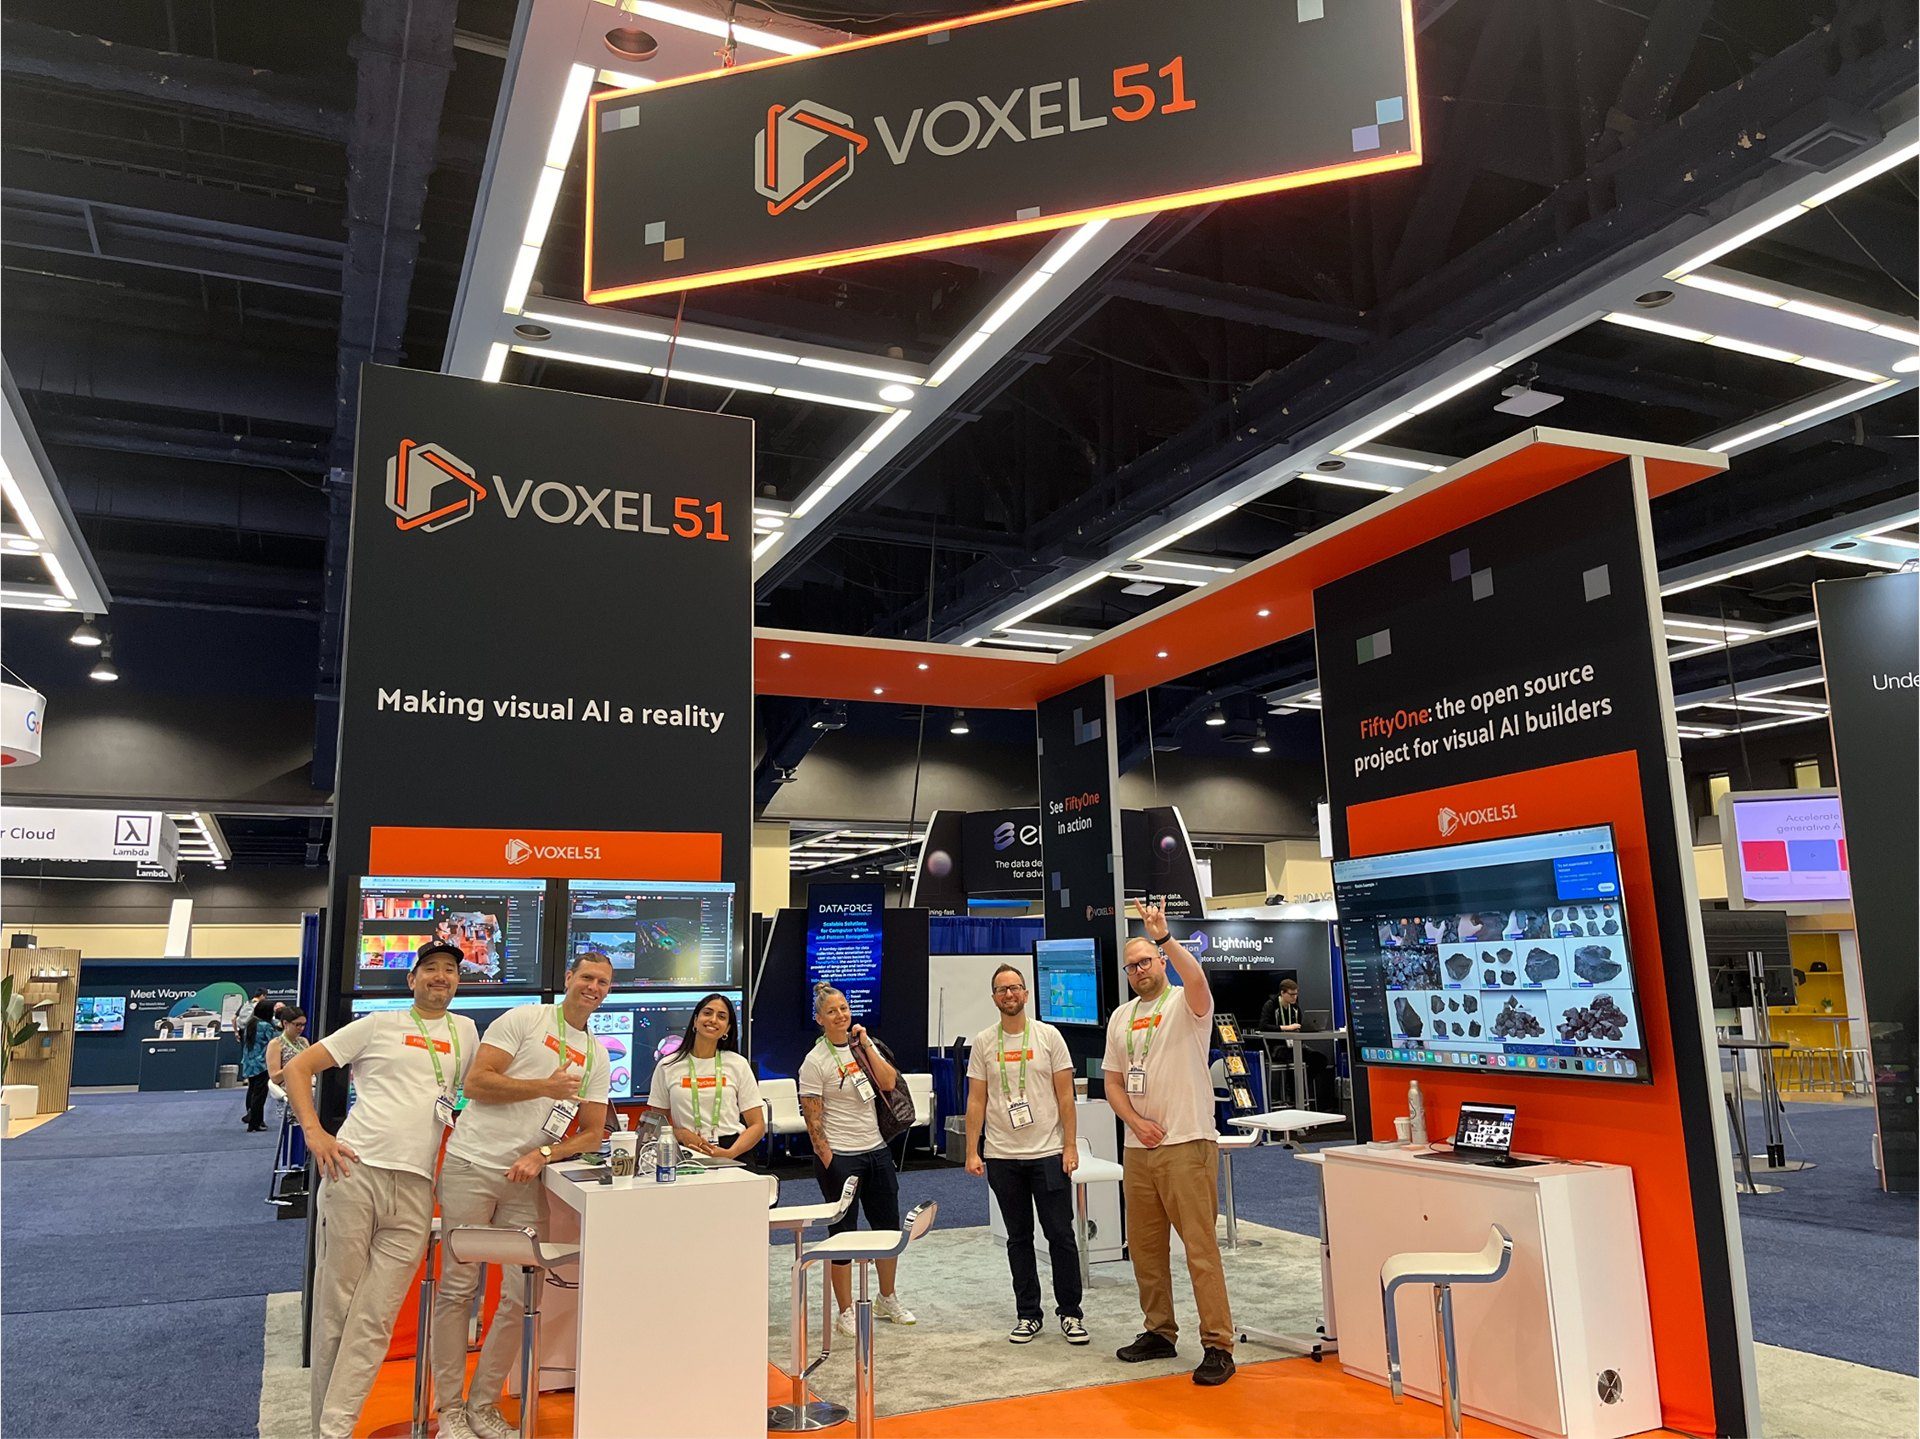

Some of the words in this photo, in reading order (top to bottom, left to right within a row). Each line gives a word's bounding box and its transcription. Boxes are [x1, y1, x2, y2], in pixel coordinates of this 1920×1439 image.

[873, 56, 1196, 165] VOXEL51
[492, 475, 730, 541] VOXEL51
[1360, 707, 1433, 740] FiftyOne:
[1435, 697, 1465, 721] the
[1470, 684, 1518, 714] open
[1524, 664, 1595, 697] source
[377, 687, 484, 721] Making
[493, 695, 573, 721] visual
[581, 699, 609, 722] AI
[619, 707, 634, 724] a
[641, 704, 725, 734] reality
[1354, 742, 1410, 777] project
[1413, 737, 1439, 758] for
[1443, 721, 1495, 752] visual
[1499, 715, 1519, 739] AI
[1525, 697, 1613, 733] builders
[1049, 801, 1064, 815] See
[1065, 792, 1100, 812] FiftyOne
[1459, 803, 1518, 826] VOXEL51
[1786, 813, 1839, 822] Accelerate
[1058, 821, 1066, 835] in
[1067, 817, 1092, 833] action
[1776, 824, 1831, 834] generative
[10, 827, 56, 840] Cloud
[113, 848, 150, 857] Lambda
[533, 846, 602, 859] VOXEL51
[995, 860, 1010, 869] The
[1010, 860, 1031, 868] data
[136, 869, 169, 878] Lambda
[1013, 870, 1025, 878] for
[819, 903, 873, 913] DATAFORCE
[1212, 936, 1262, 951] Lightning
[1223, 955, 1247, 963] PyTorch
[1248, 955, 1275, 964] Lightning
[130, 989, 156, 999] Meet
[158, 988, 197, 1000] Waymo
